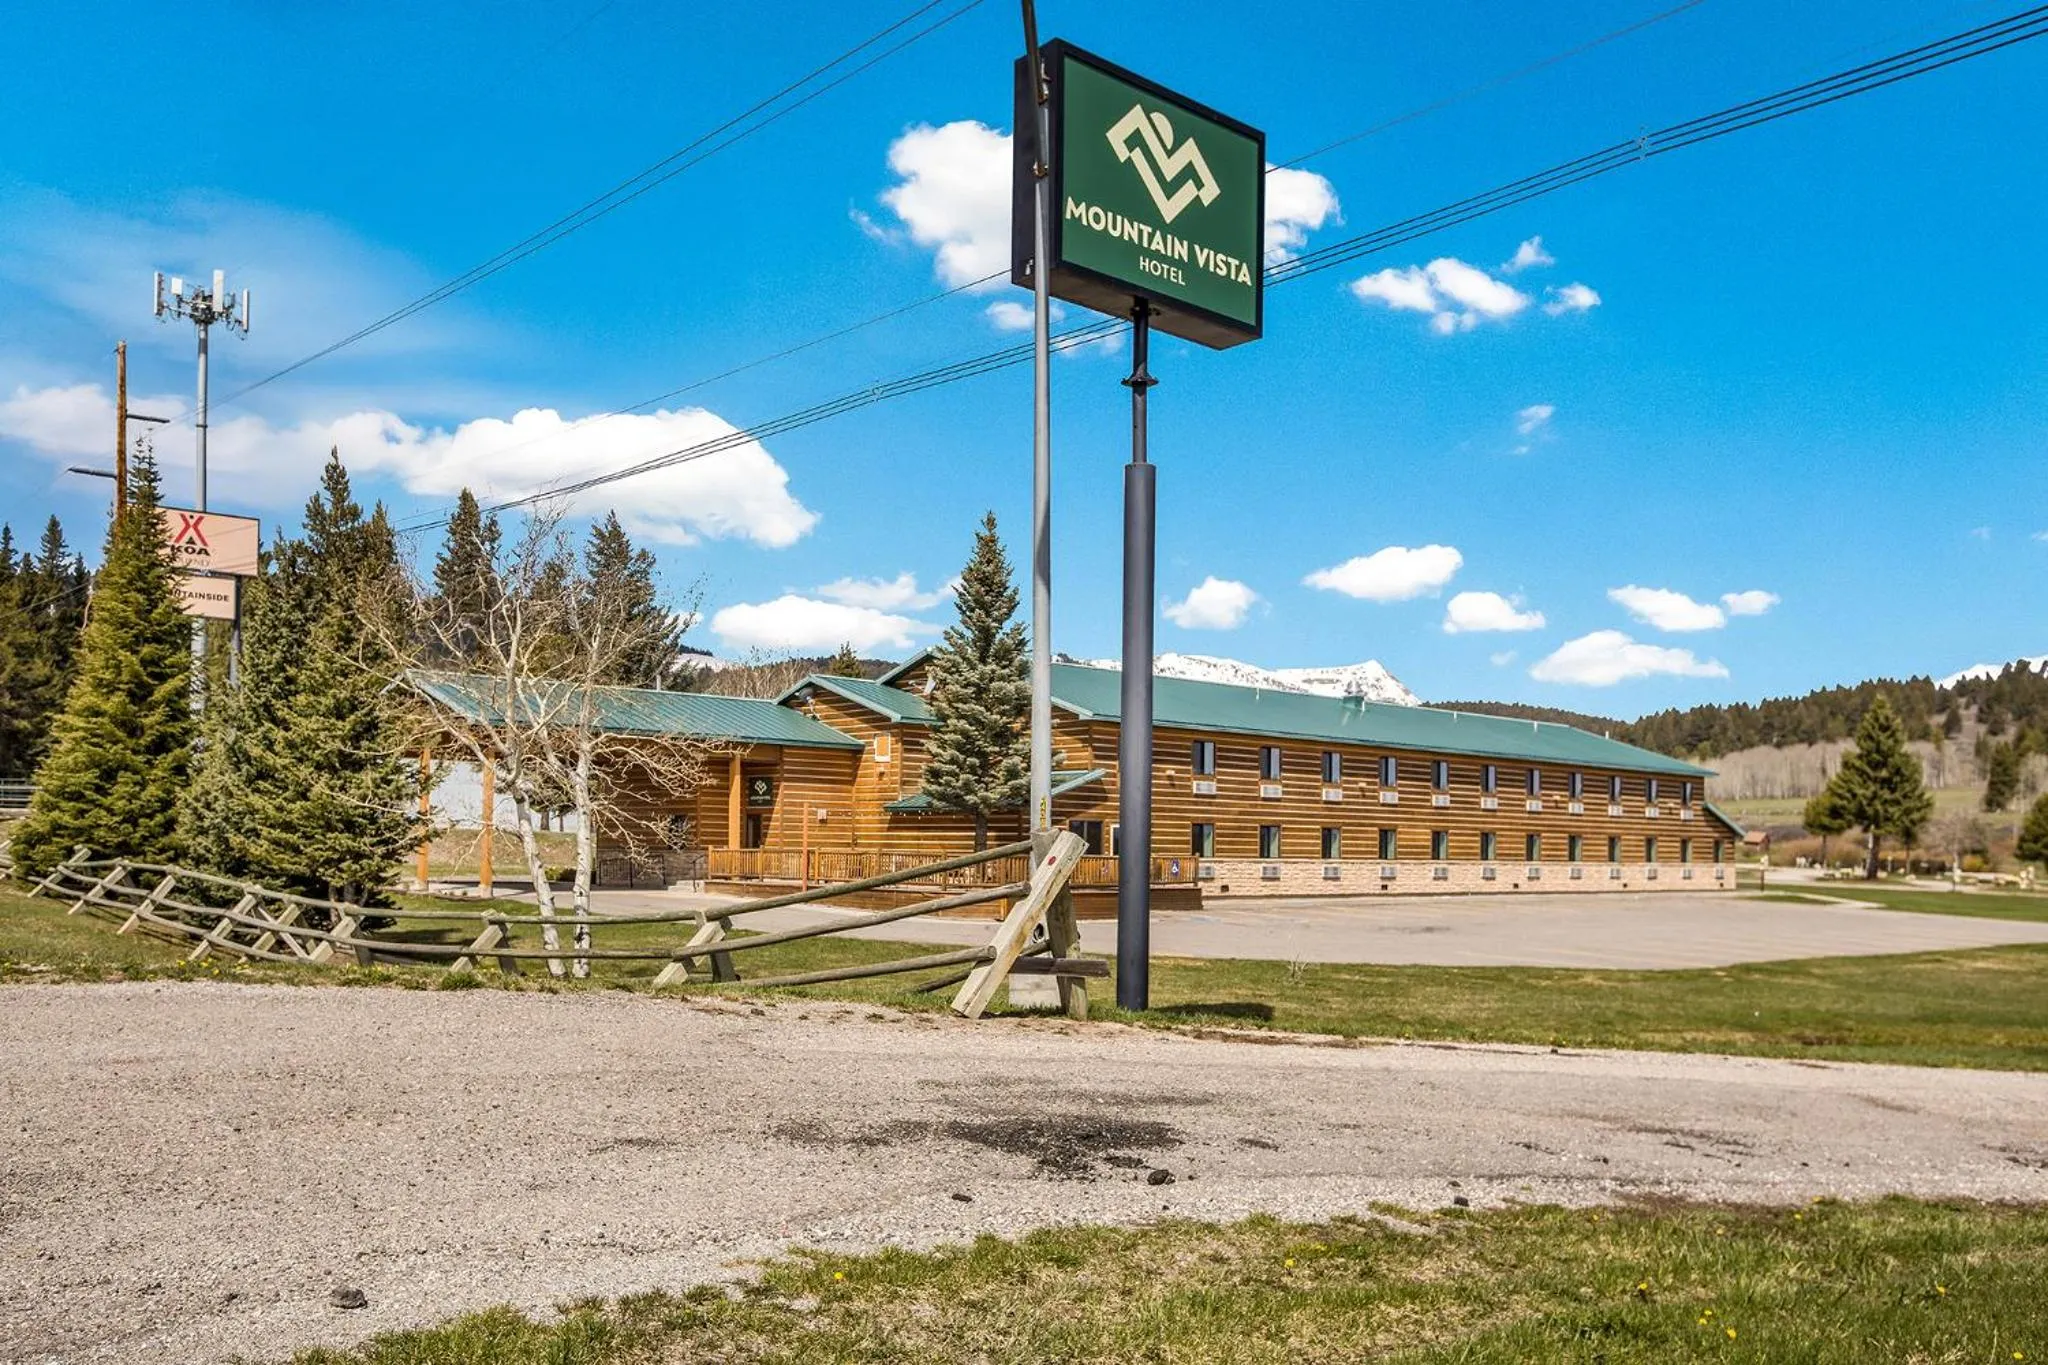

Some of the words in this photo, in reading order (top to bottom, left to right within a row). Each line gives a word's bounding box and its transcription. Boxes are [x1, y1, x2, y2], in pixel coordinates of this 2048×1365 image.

[1065, 196, 1188, 263] MOUNTAIN
[1194, 244, 1252, 286] VISTA
[1139, 256, 1186, 286] HOTEL
[171, 545, 210, 556] KOA
